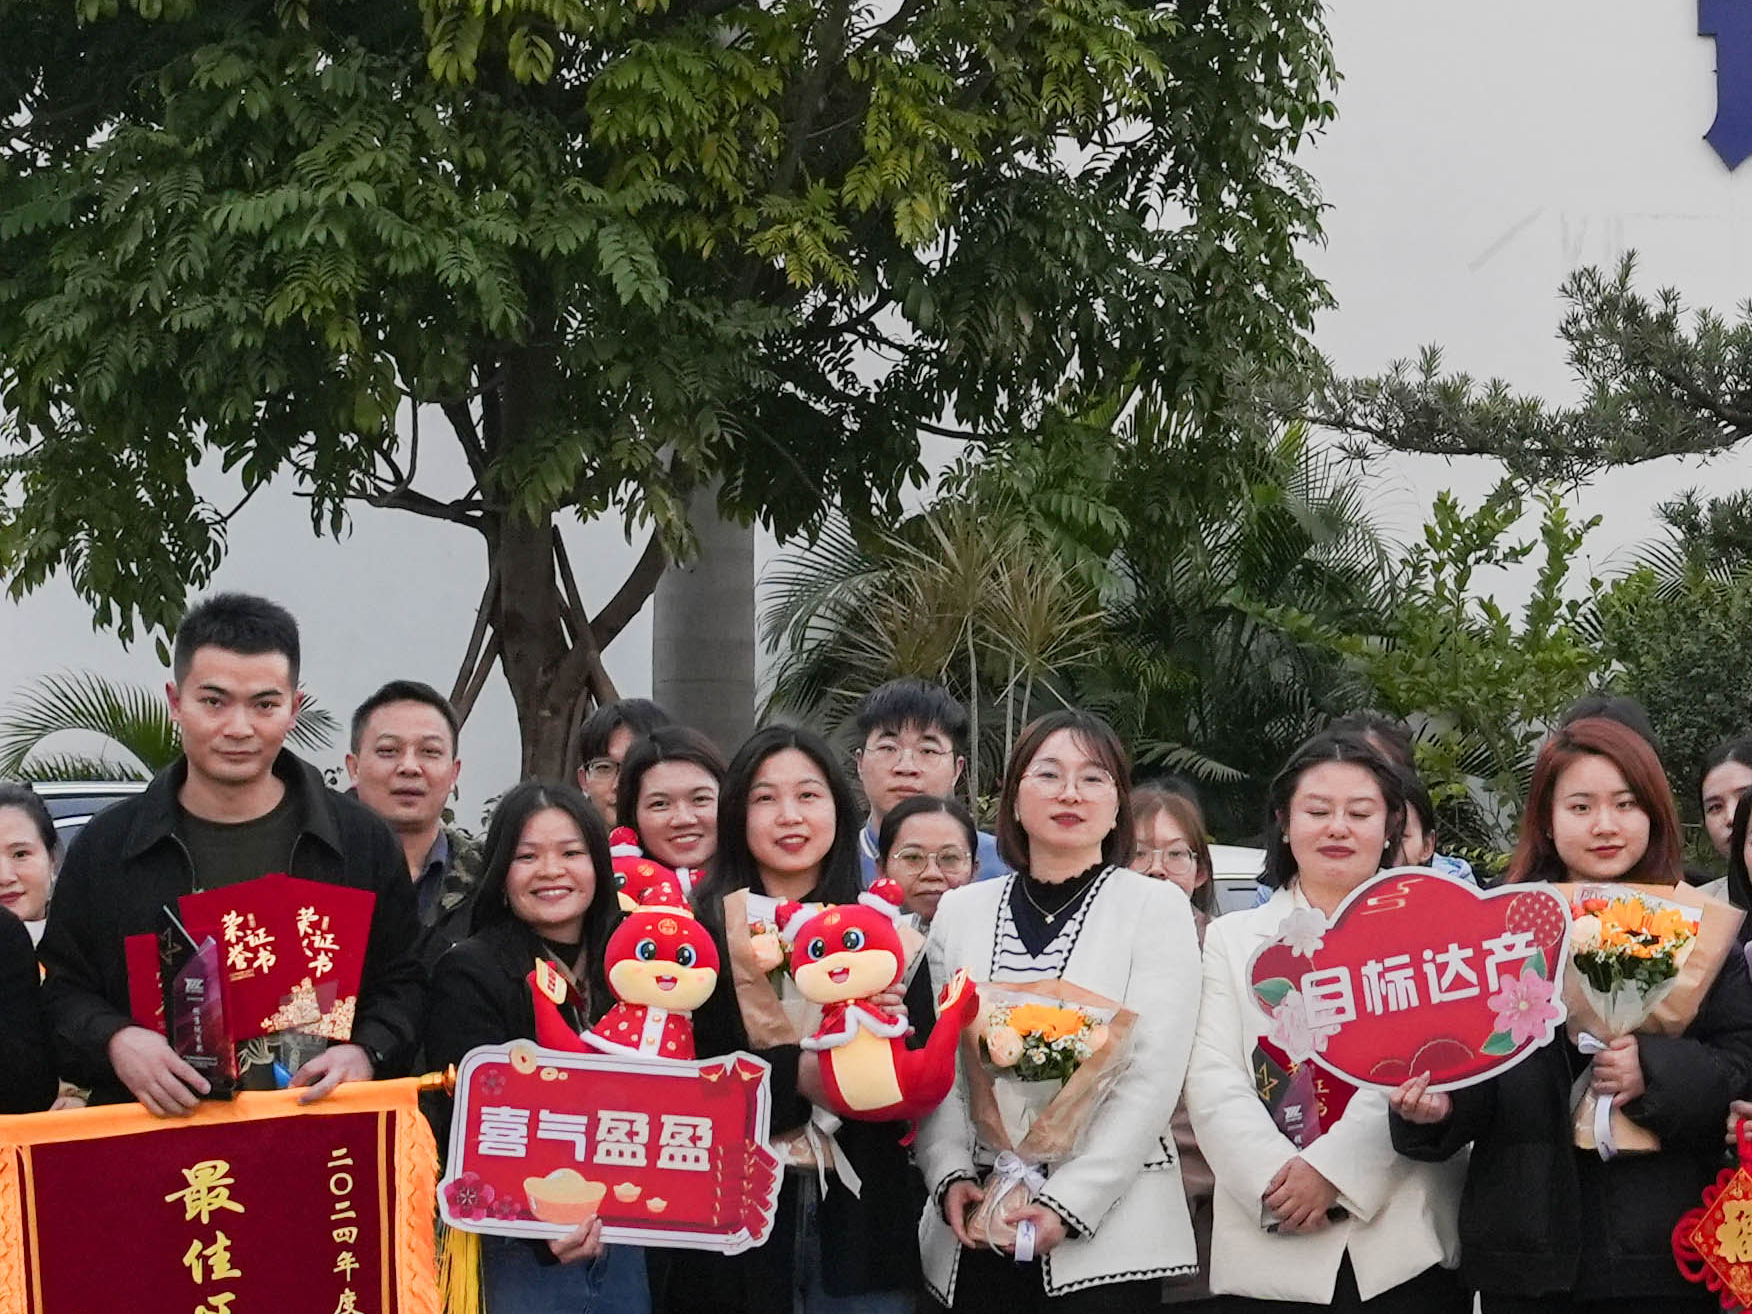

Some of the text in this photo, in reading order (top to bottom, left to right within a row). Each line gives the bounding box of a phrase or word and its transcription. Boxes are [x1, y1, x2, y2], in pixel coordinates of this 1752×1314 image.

[1300, 929, 1538, 1031] 目标达产
[476, 1105, 715, 1172] 喜气盈盈
